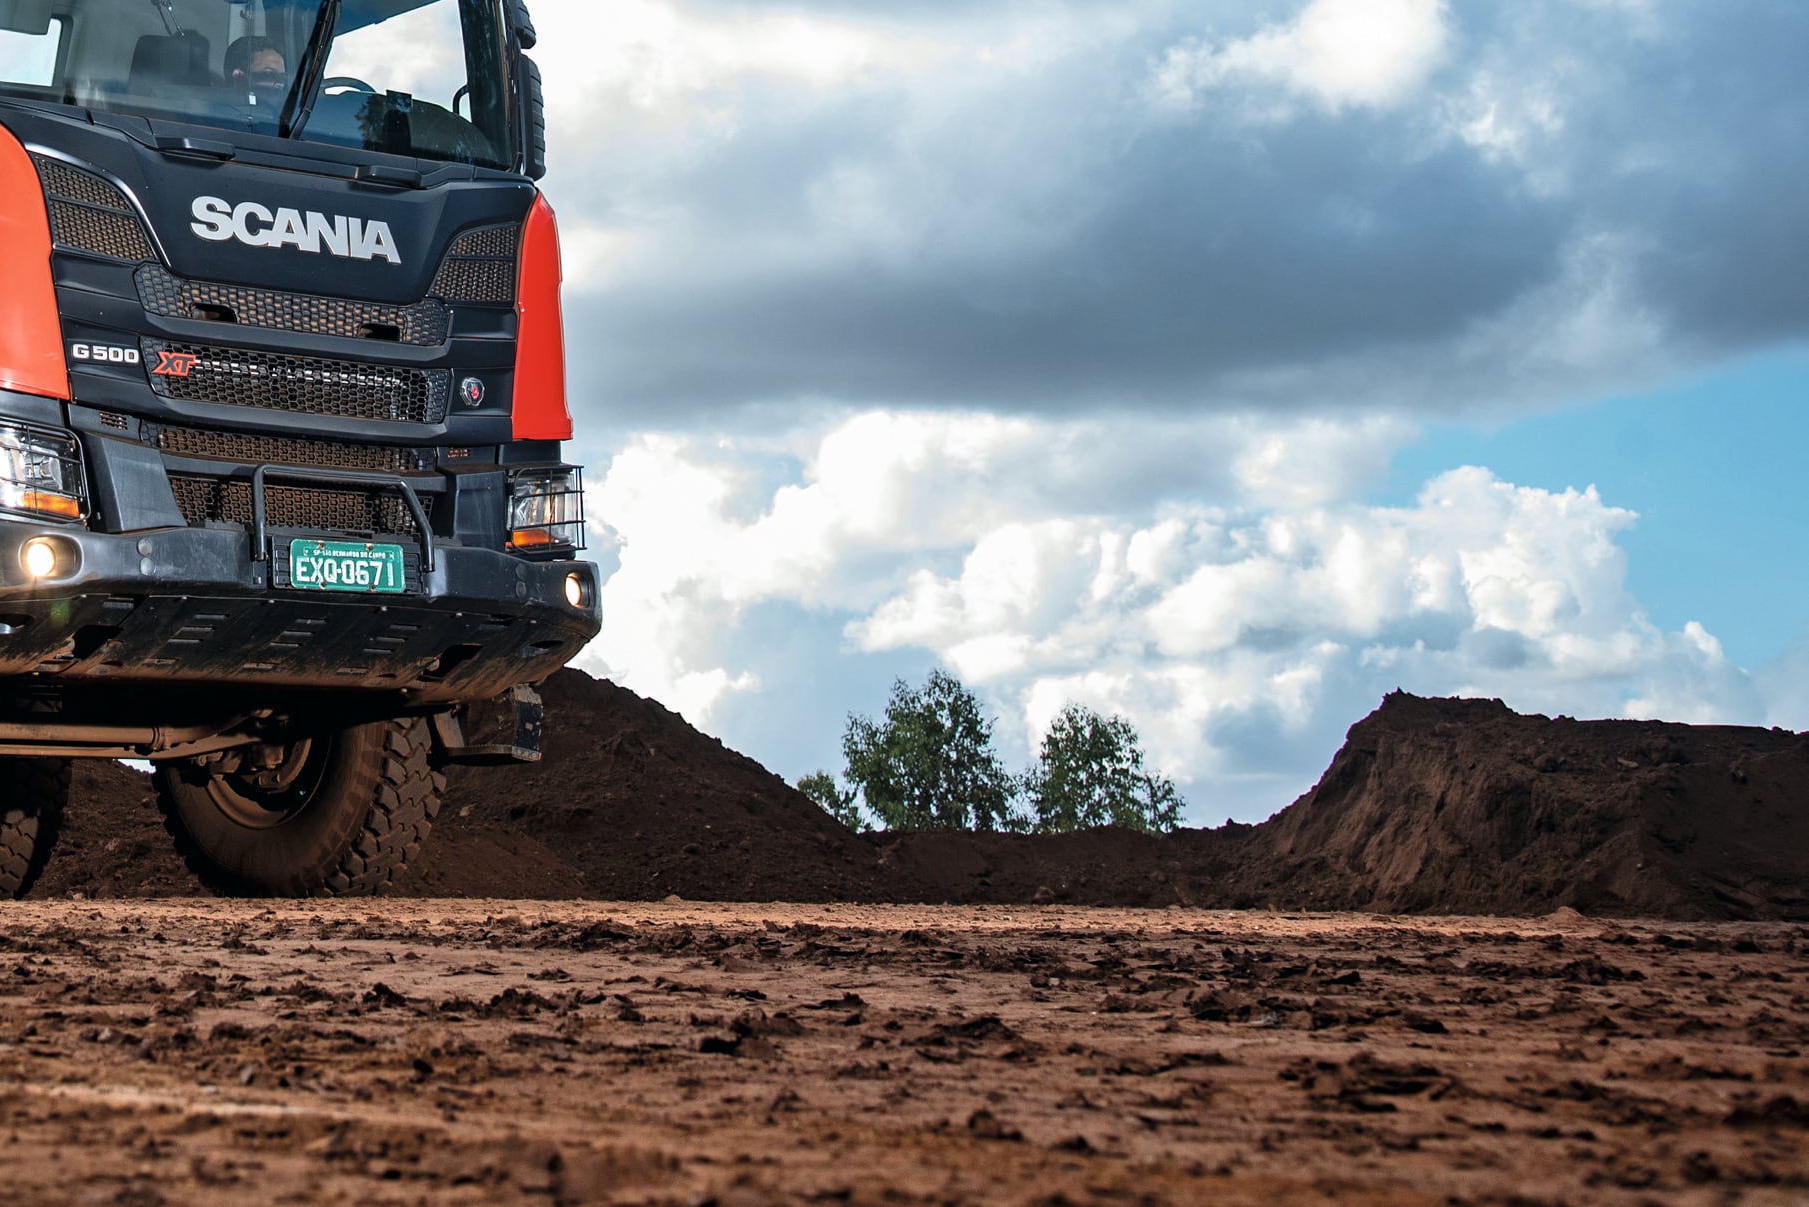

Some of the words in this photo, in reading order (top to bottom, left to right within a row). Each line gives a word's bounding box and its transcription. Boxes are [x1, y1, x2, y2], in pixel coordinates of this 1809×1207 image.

[191, 195, 401, 264] SCANIA
[152, 351, 196, 377] XT
[296, 556, 395, 587] EXQ-0671
